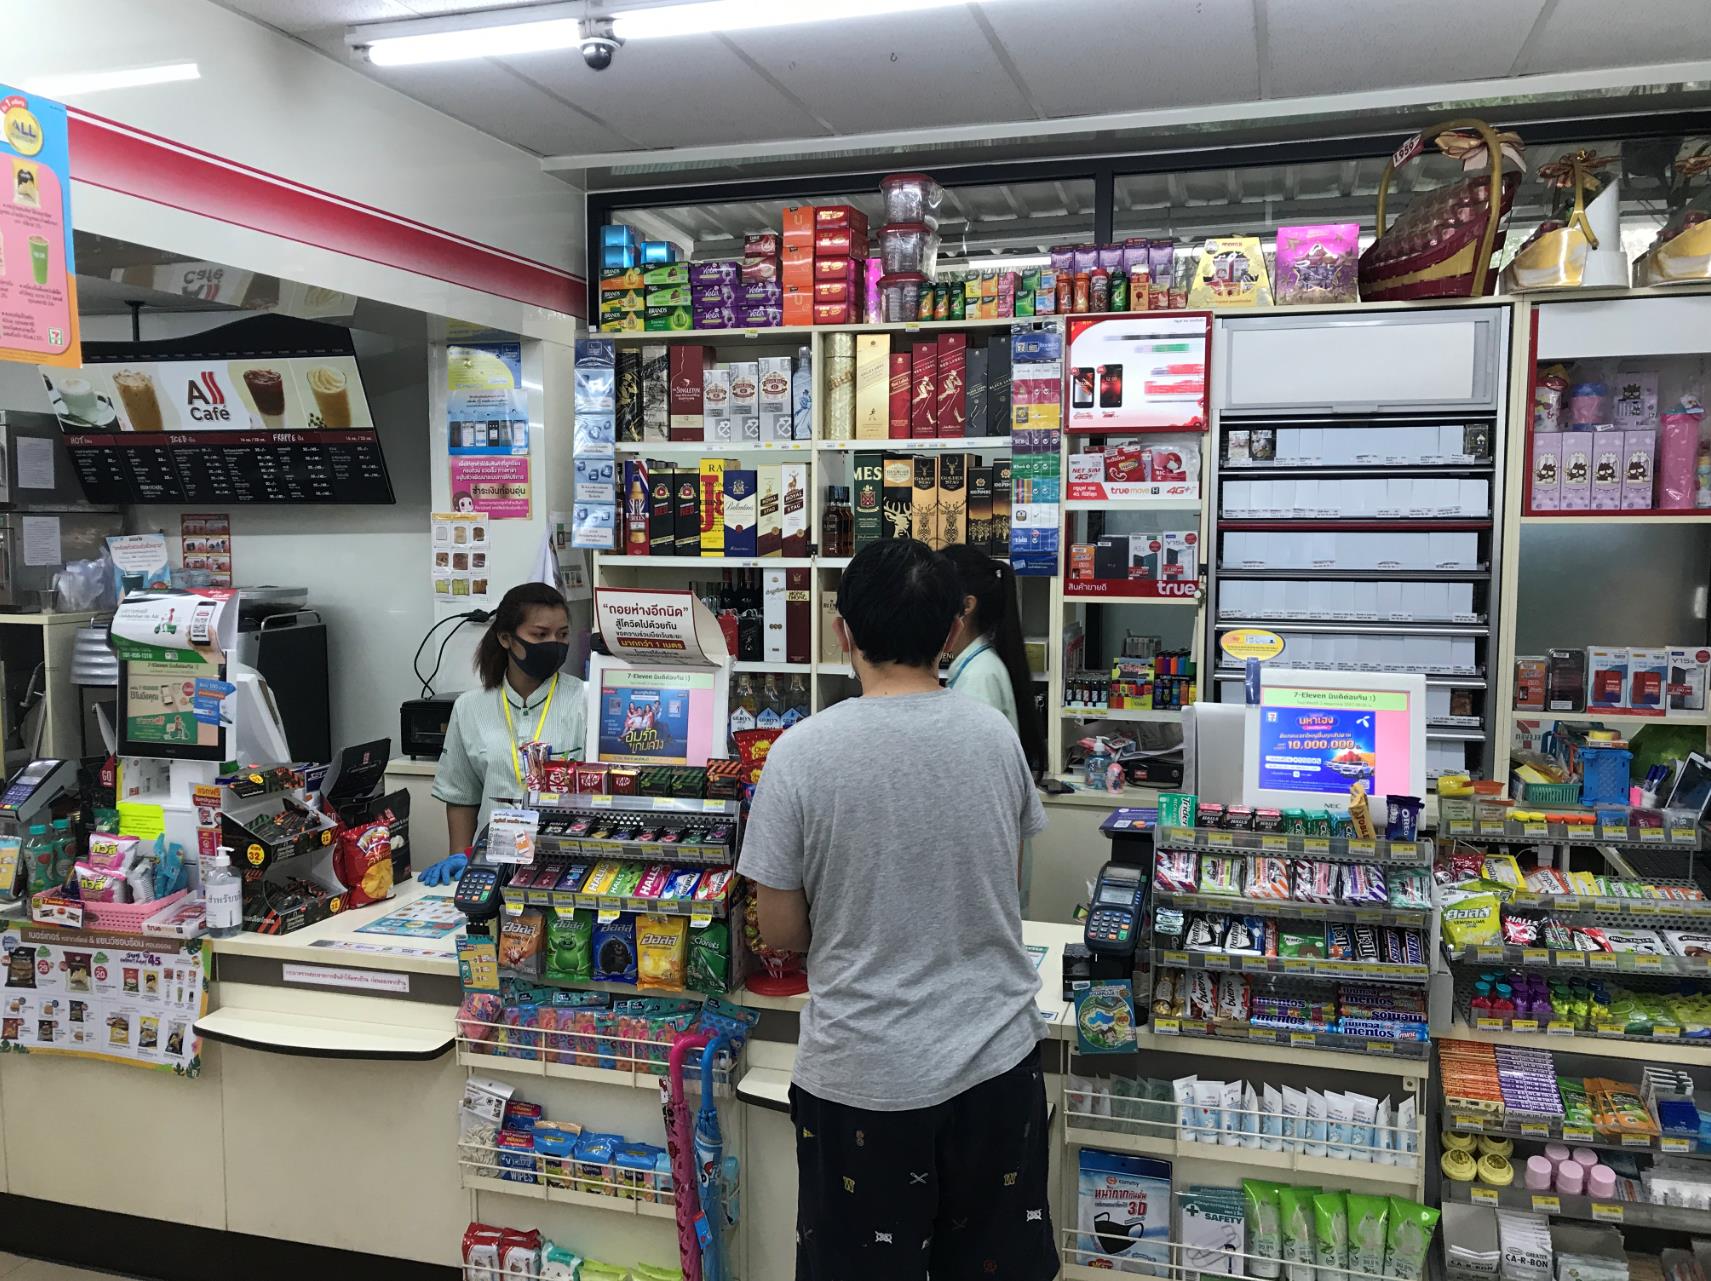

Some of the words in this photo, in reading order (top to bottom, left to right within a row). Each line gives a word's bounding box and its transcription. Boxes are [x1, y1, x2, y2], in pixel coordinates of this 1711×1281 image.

[190, 404, 230, 422] Café
[854, 466, 882, 481] MES
[785, 491, 804, 502] ROYAL
[786, 502, 803, 513] STAG
[1068, 581, 1107, 591] สินค้าขายดี
[1157, 581, 1196, 595] true
[615, 618, 678, 630] สู้โควิดไปด้วยกัน
[662, 641, 683, 649] เมตร
[1293, 691, 1326, 699] 7-Eleven
[1401, 808, 1411, 836] OREO
[588, 863, 610, 892] HALLS
[611, 874, 625, 894] HALLS
[640, 864, 662, 896] HALLS
[1508, 915, 1540, 926] HALLS
[694, 937, 720, 950] Clorets
[147, 954, 162, 967] 45
[95, 970, 106, 979] 20
[1197, 971, 1208, 1004] bueno
[1226, 981, 1236, 1007] bueno
[1257, 1013, 1306, 1025] mentos
[1344, 1027, 1395, 1038] mentos
[1127, 1202, 1147, 1216] 3D
[1205, 1212, 1242, 1225] SAFETY
[1505, 1254, 1549, 1268] CA-R-BON
